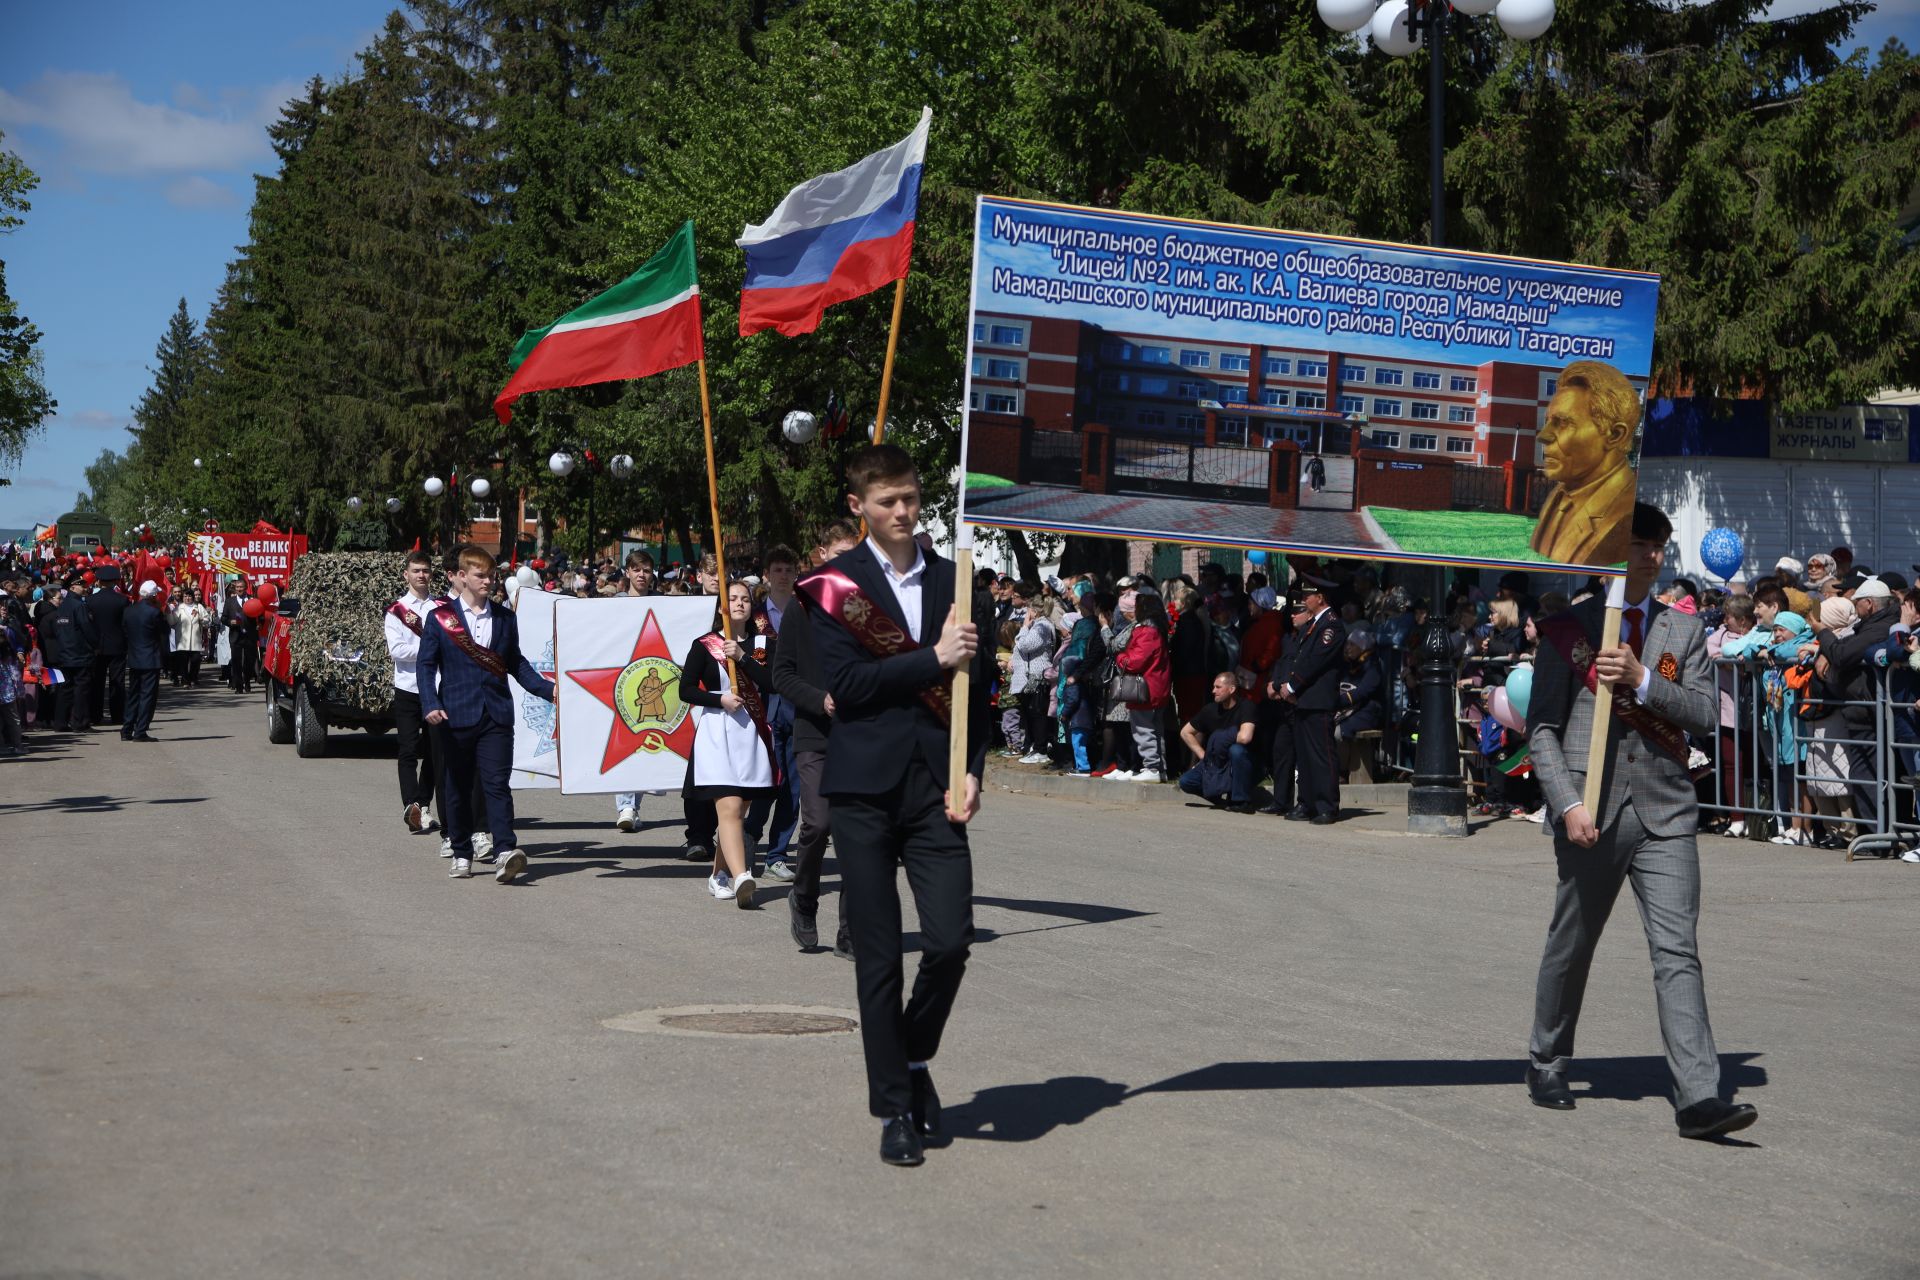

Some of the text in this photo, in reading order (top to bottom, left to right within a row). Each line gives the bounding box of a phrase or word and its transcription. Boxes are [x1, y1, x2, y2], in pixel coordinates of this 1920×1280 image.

[994, 214, 1622, 307] Муниципальное бюджетное общеобразовательное учреждение
[1053, 248, 1557, 325] "Лицей №2 им. ак. К.А. Валиева города Мамадыш"
[993, 268, 1613, 358] Мамадышского муниципального района Республики Татарстан
[1777, 415, 1837, 430] ГАЗЕТЫ
[1843, 416, 1852, 430] И
[1777, 434, 1856, 449] ЖУРНАЛЫ
[197, 535, 226, 563] 78
[248, 540, 290, 553] ВЕЛИКО
[250, 555, 288, 568] ПОБЕД
